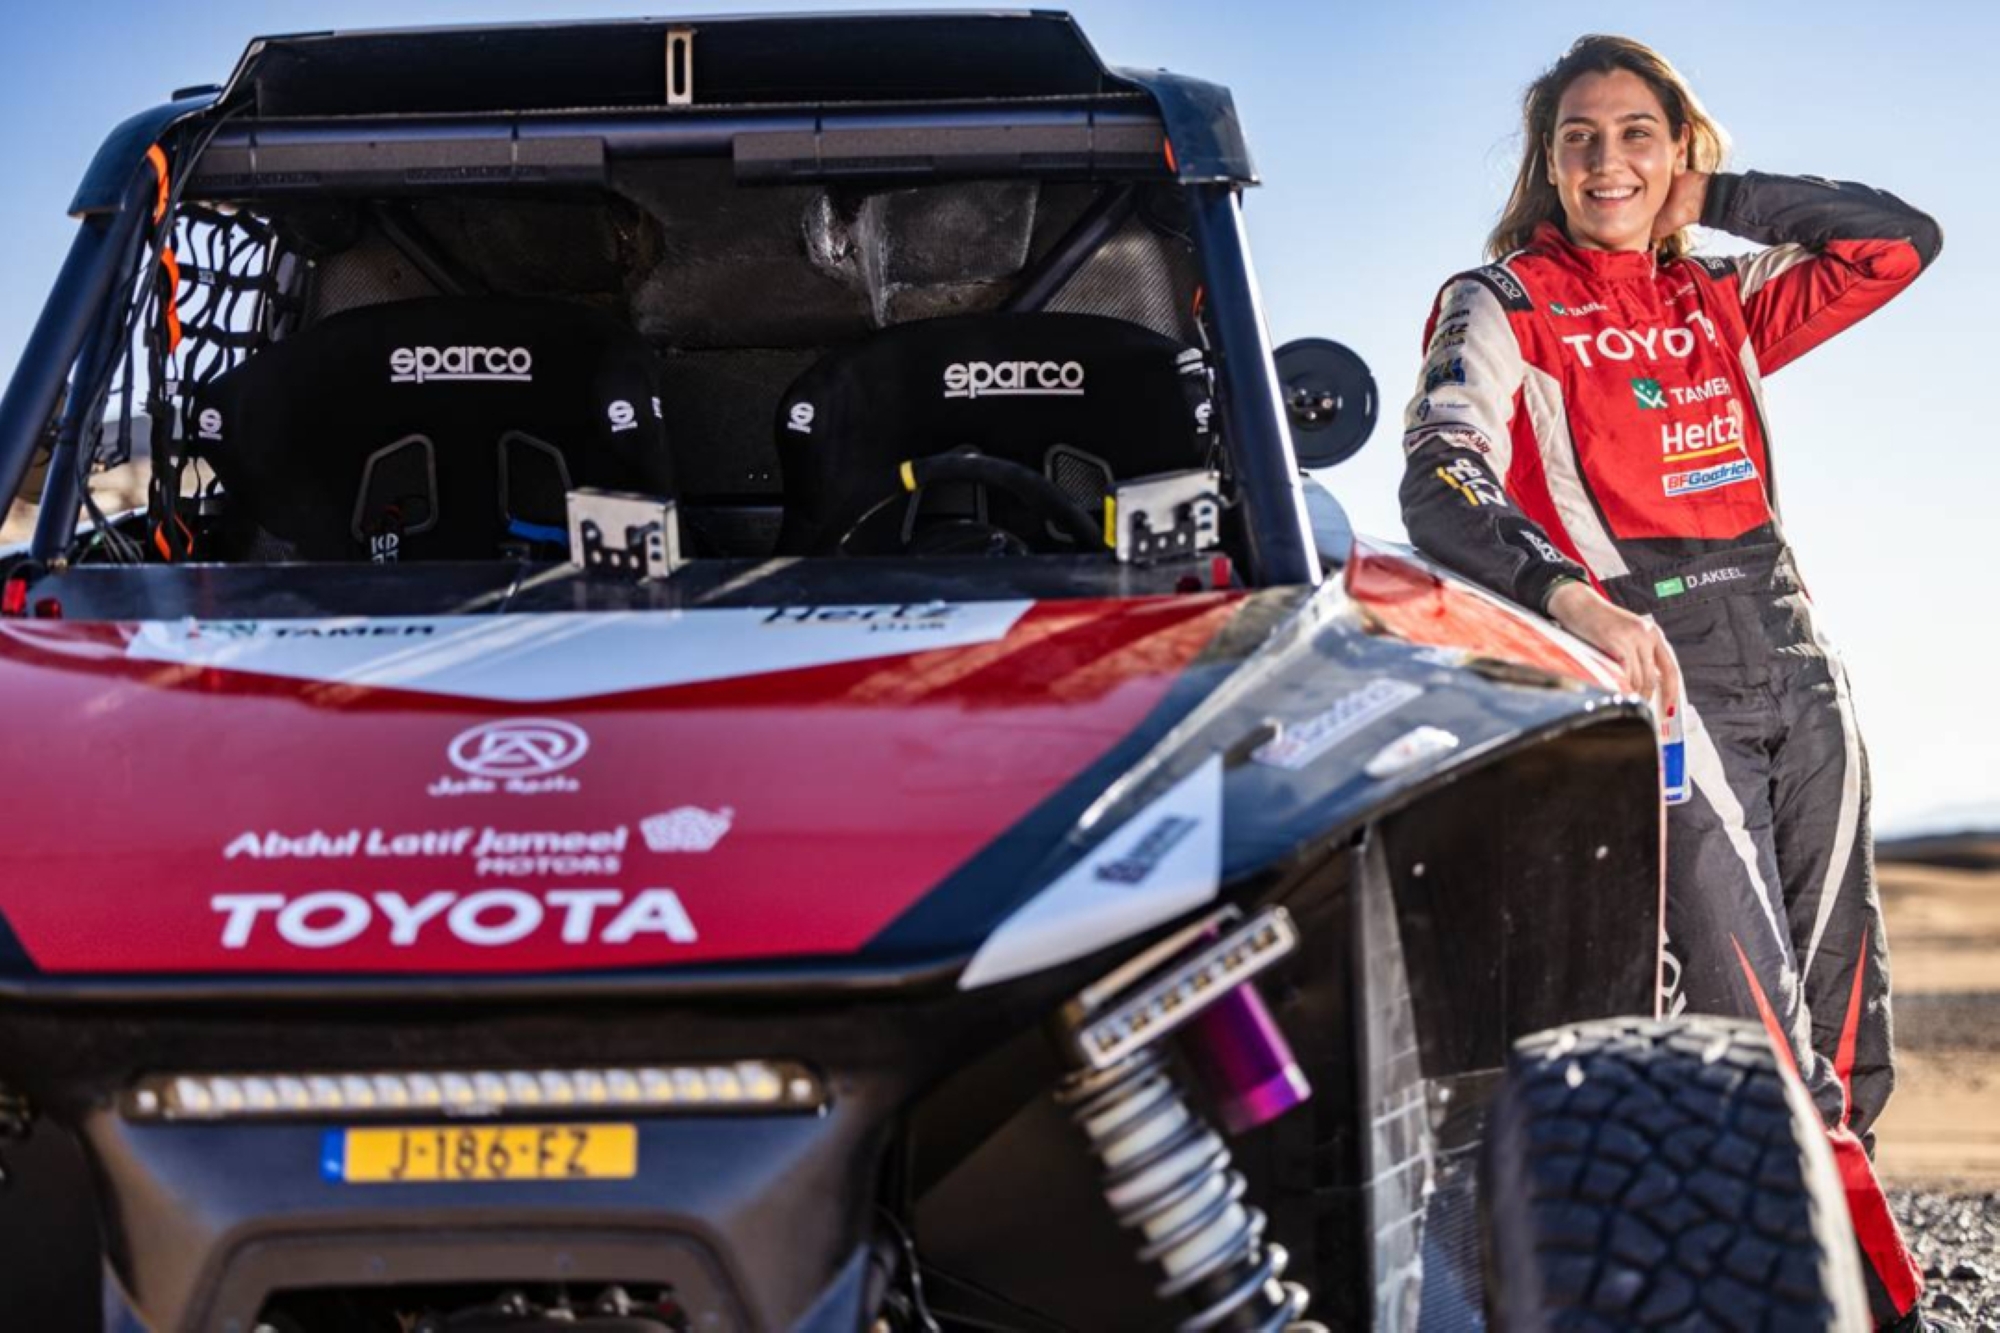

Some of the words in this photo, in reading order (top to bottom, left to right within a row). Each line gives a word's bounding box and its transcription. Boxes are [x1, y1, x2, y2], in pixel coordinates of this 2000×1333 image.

[390, 346, 533, 384] sparco
[943, 361, 1085, 399] sparco
[1661, 414, 1741, 454] Hertz
[1667, 461, 1753, 489] BFGoodrich
[224, 829, 361, 858] Abdul
[365, 828, 474, 857] Latif
[471, 826, 628, 858] Jameel
[476, 856, 622, 876] MOTORS
[211, 889, 699, 948] TOYOTA
[390, 1129, 588, 1179] J-186-FZ
